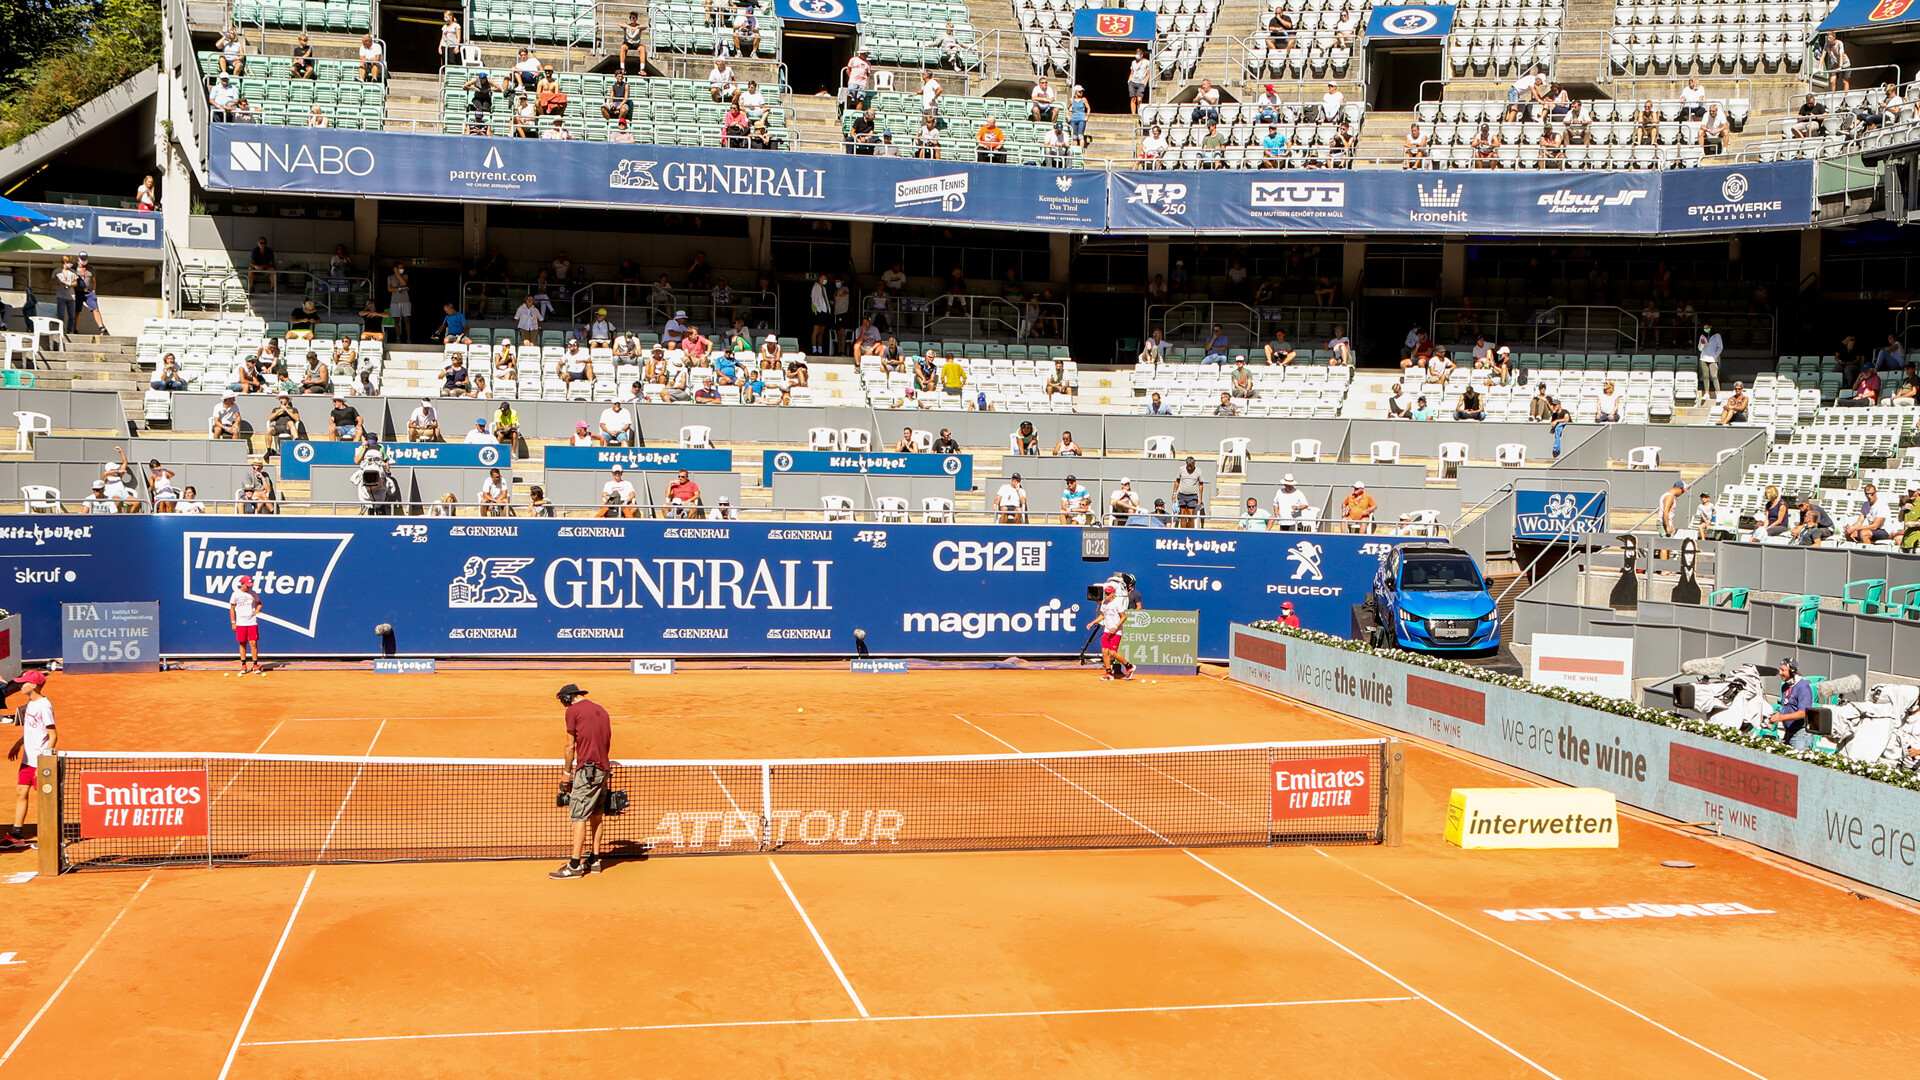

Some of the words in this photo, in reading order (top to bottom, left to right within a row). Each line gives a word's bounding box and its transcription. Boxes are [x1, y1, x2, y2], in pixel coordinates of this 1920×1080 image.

[264, 143, 375, 176] NABO
[450, 170, 536, 182] partyrent.com
[662, 162, 826, 198] GENERALI
[1038, 195, 1071, 204] Kempinski
[1125, 183, 1187, 204] ATP
[1256, 186, 1340, 202] MUT
[1537, 190, 1605, 206] albus
[1162, 204, 1187, 215] 250
[1410, 210, 1468, 222] kronehit
[1688, 201, 1782, 216] STADTWERKE
[1702, 212, 1766, 222] Kitzbühel
[106, 220, 148, 236] Tirol
[598, 450, 679, 468] Kitzbühel
[830, 455, 907, 472] Kitzbühel
[0, 524, 94, 546] Kitzbühel
[390, 524, 428, 536] ATP
[466, 526, 518, 536] GENERALI
[574, 526, 625, 538] GENERALI
[679, 528, 730, 540] GENERALI
[783, 530, 832, 540] GENERALI
[853, 530, 887, 542] ATP
[1022, 547, 1040, 556] CB
[1086, 540, 1106, 555] 0:23
[1155, 536, 1237, 557] Kitzbühel
[1358, 542, 1392, 554] ATP
[194, 541, 273, 569] inter
[932, 540, 1014, 572] CB12
[1022, 557, 1040, 566] 12
[14, 567, 60, 584] skruf
[1169, 575, 1208, 591] skruf
[544, 558, 834, 610] GENERALI
[1266, 584, 1342, 596] PEUGEOT
[68, 604, 100, 620] IFA
[903, 598, 1076, 639] magnofit
[74, 628, 116, 638] MATCH
[119, 628, 148, 637] TIME
[466, 628, 518, 638] GENERALI
[572, 628, 624, 638] GENERALI
[678, 628, 728, 639] GENERALI
[782, 628, 831, 639] GENERALI
[1123, 633, 1154, 642] SERVE
[1158, 634, 1190, 643] SPEED
[82, 640, 140, 660] 0:56
[1121, 644, 1160, 663] 141
[1162, 654, 1194, 664] Km/h
[376, 660, 432, 673] Kitzbühel
[640, 662, 666, 672] Tirol
[852, 660, 906, 673] Kitzbühel
[1296, 662, 1312, 684] we
[1314, 667, 1332, 691] are
[1334, 666, 1356, 697] the
[1360, 672, 1393, 706] wine
[1428, 717, 1440, 732] THE
[1443, 722, 1461, 738] WINE
[1502, 716, 1524, 746] we
[1528, 724, 1554, 754] are
[1558, 725, 1590, 766] the
[1596, 736, 1647, 782] wine
[1276, 768, 1364, 791] Emirates
[1674, 754, 1792, 806] SCHEIBLHOFER
[86, 782, 200, 806] Emirates
[1290, 792, 1308, 808] FLY
[1311, 790, 1352, 808] BETTER
[104, 808, 128, 826] FLY
[132, 808, 184, 826] BETTER
[1470, 810, 1613, 834] interwetten
[1704, 801, 1724, 821] THE
[1728, 808, 1757, 831] WINE
[637, 811, 760, 849] ATP
[772, 810, 904, 846] TOUR
[1826, 808, 1863, 850] we
[1871, 824, 1916, 866] are
